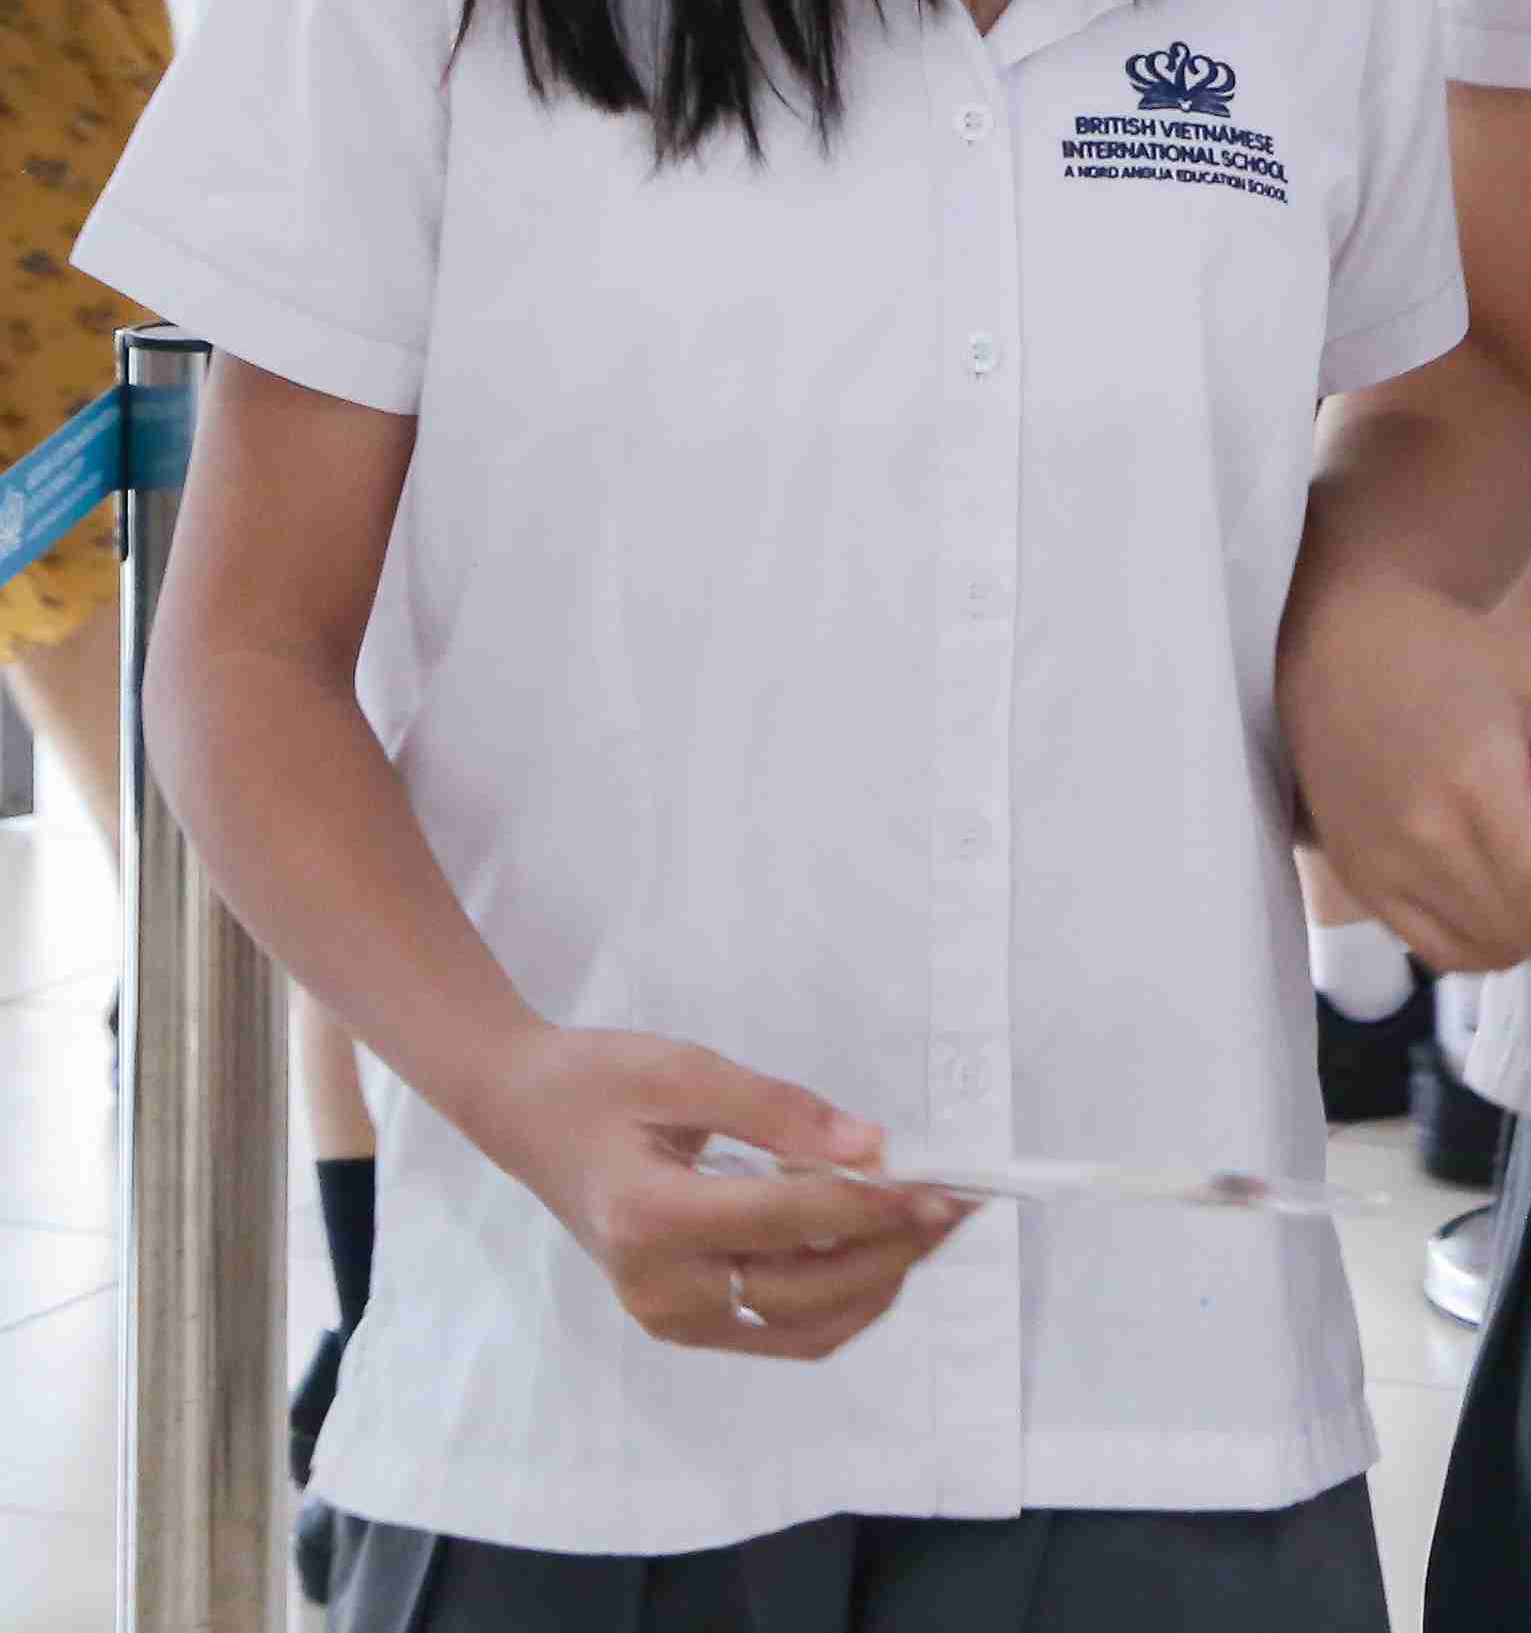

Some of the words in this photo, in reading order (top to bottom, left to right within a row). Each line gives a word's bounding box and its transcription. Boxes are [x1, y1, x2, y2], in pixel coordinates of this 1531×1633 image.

[1075, 117, 1156, 137] BRITISH
[1159, 120, 1275, 155] VIETNAMESE
[1062, 140, 1222, 168] INTERNATIONAL
[1221, 150, 1289, 184] SCHOOL
[1064, 167, 1075, 178] A
[1077, 166, 1119, 180] NORD
[1121, 166, 1173, 182] ANGLIA
[1176, 169, 1246, 191] EDUCATION
[1247, 180, 1289, 205] SCHOOL
